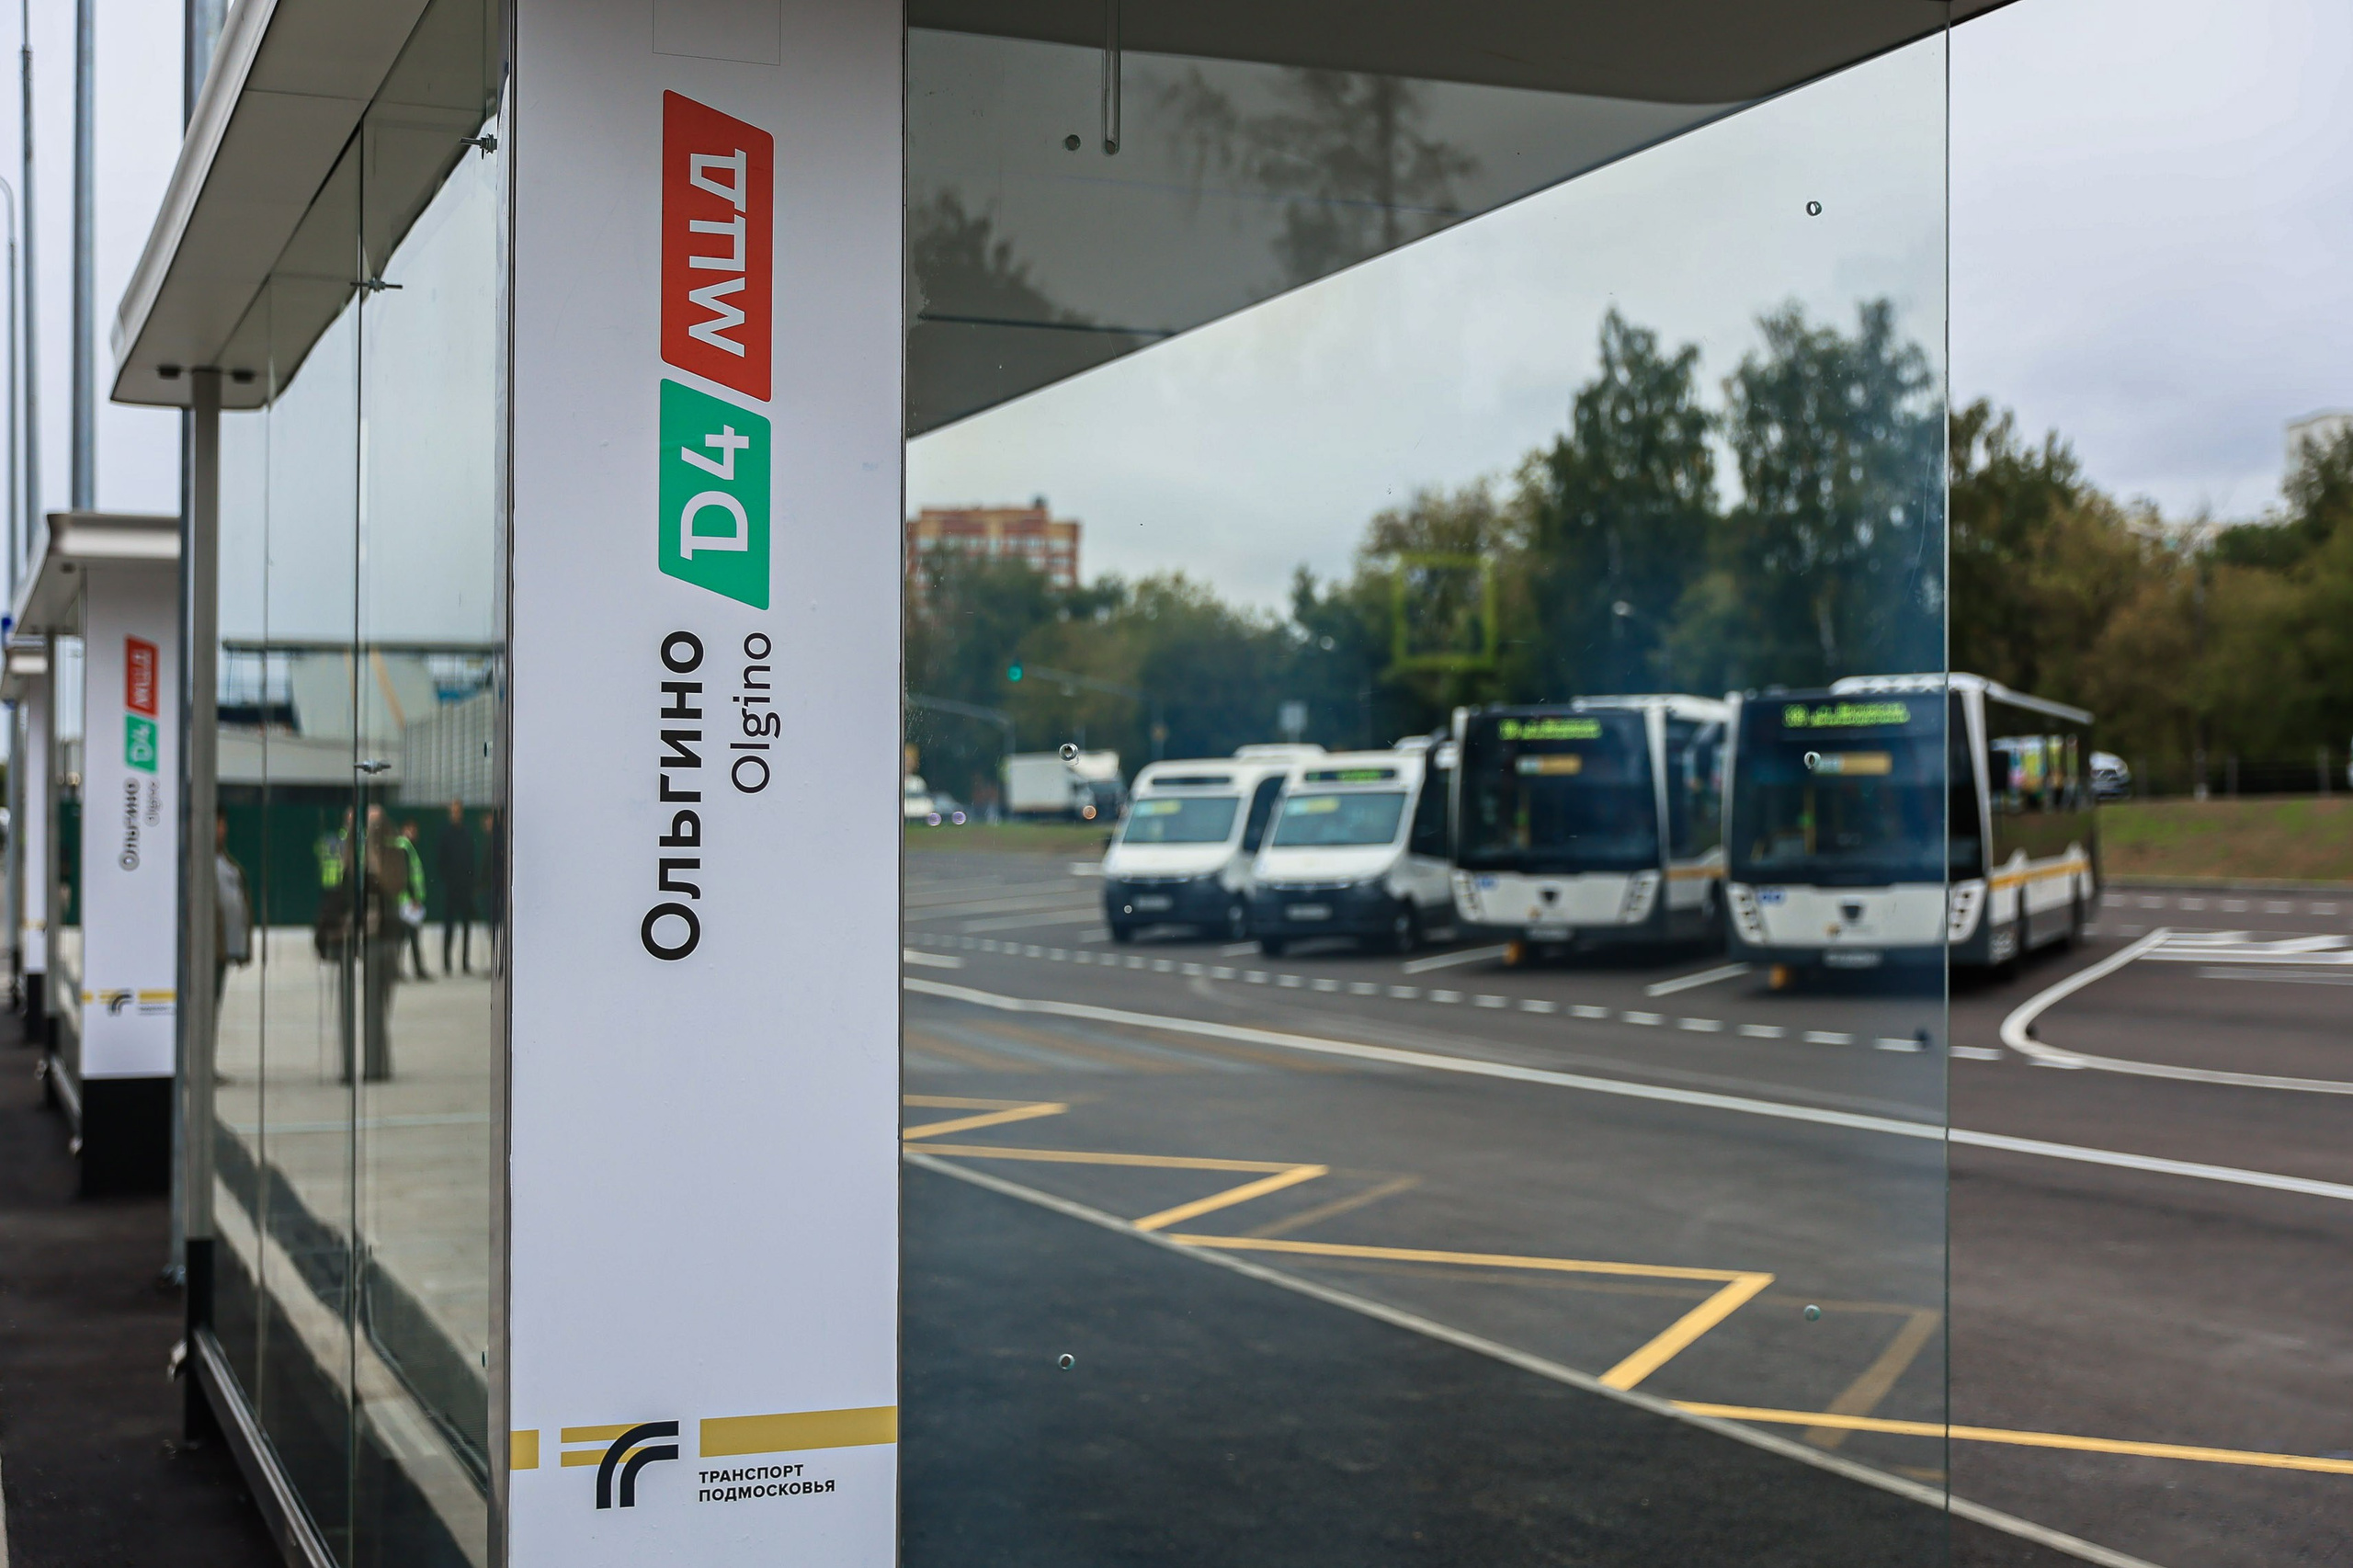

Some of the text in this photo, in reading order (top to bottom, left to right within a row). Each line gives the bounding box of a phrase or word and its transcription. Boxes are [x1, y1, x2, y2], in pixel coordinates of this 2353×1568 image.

[641, 148, 750, 961] Ольгино D4 МЦД
[729, 632, 781, 793] Olgino
[699, 1463, 804, 1484] ТРАНСПОРТ
[699, 1480, 835, 1503] ПОДМОСКОВЬЯ
